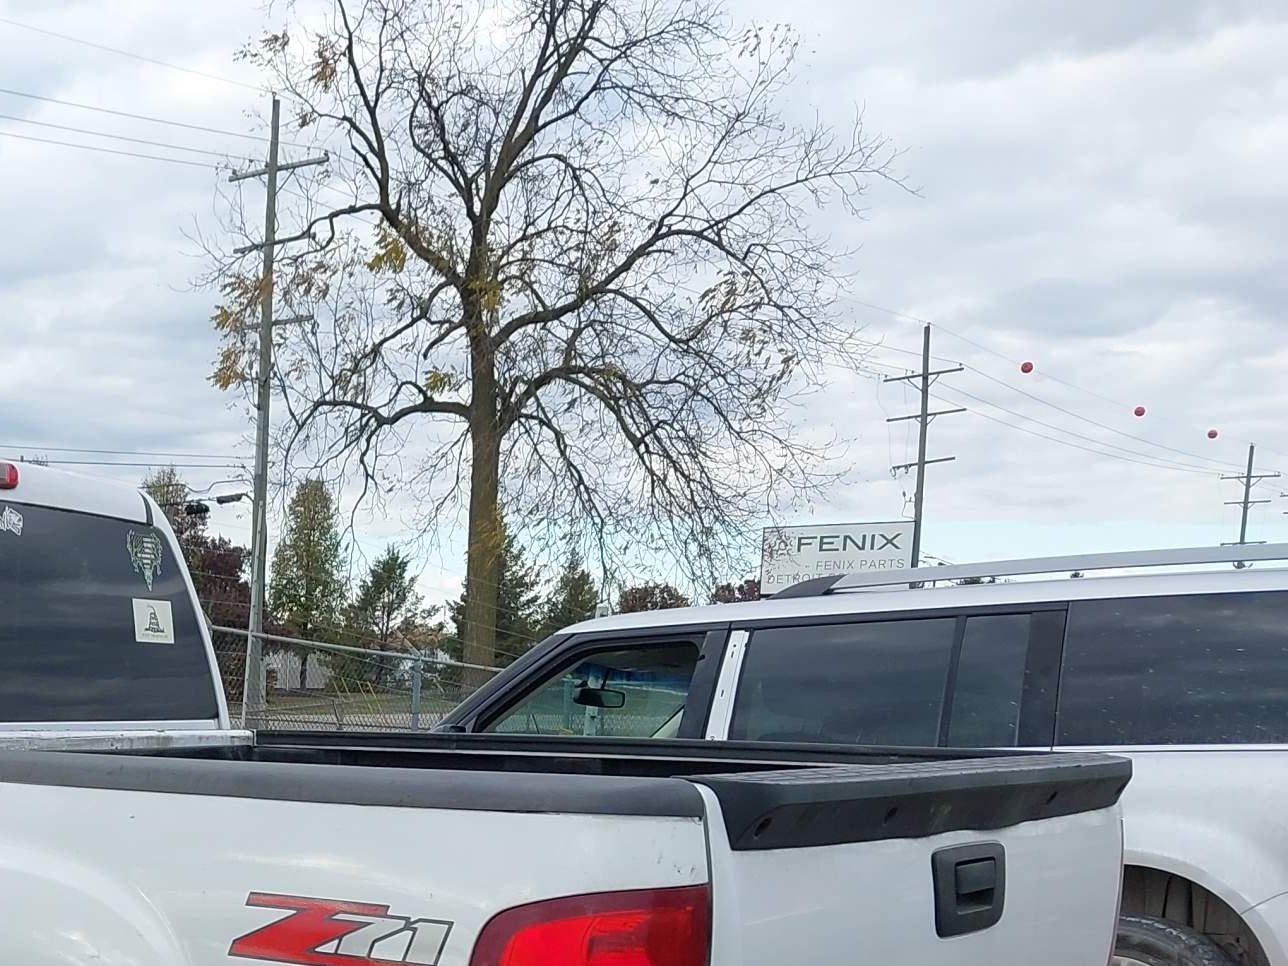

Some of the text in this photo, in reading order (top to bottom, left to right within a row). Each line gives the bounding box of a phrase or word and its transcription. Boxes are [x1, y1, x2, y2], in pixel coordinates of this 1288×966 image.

[797, 533, 903, 552] FENIX
[815, 558, 905, 571] FENIX PARTS
